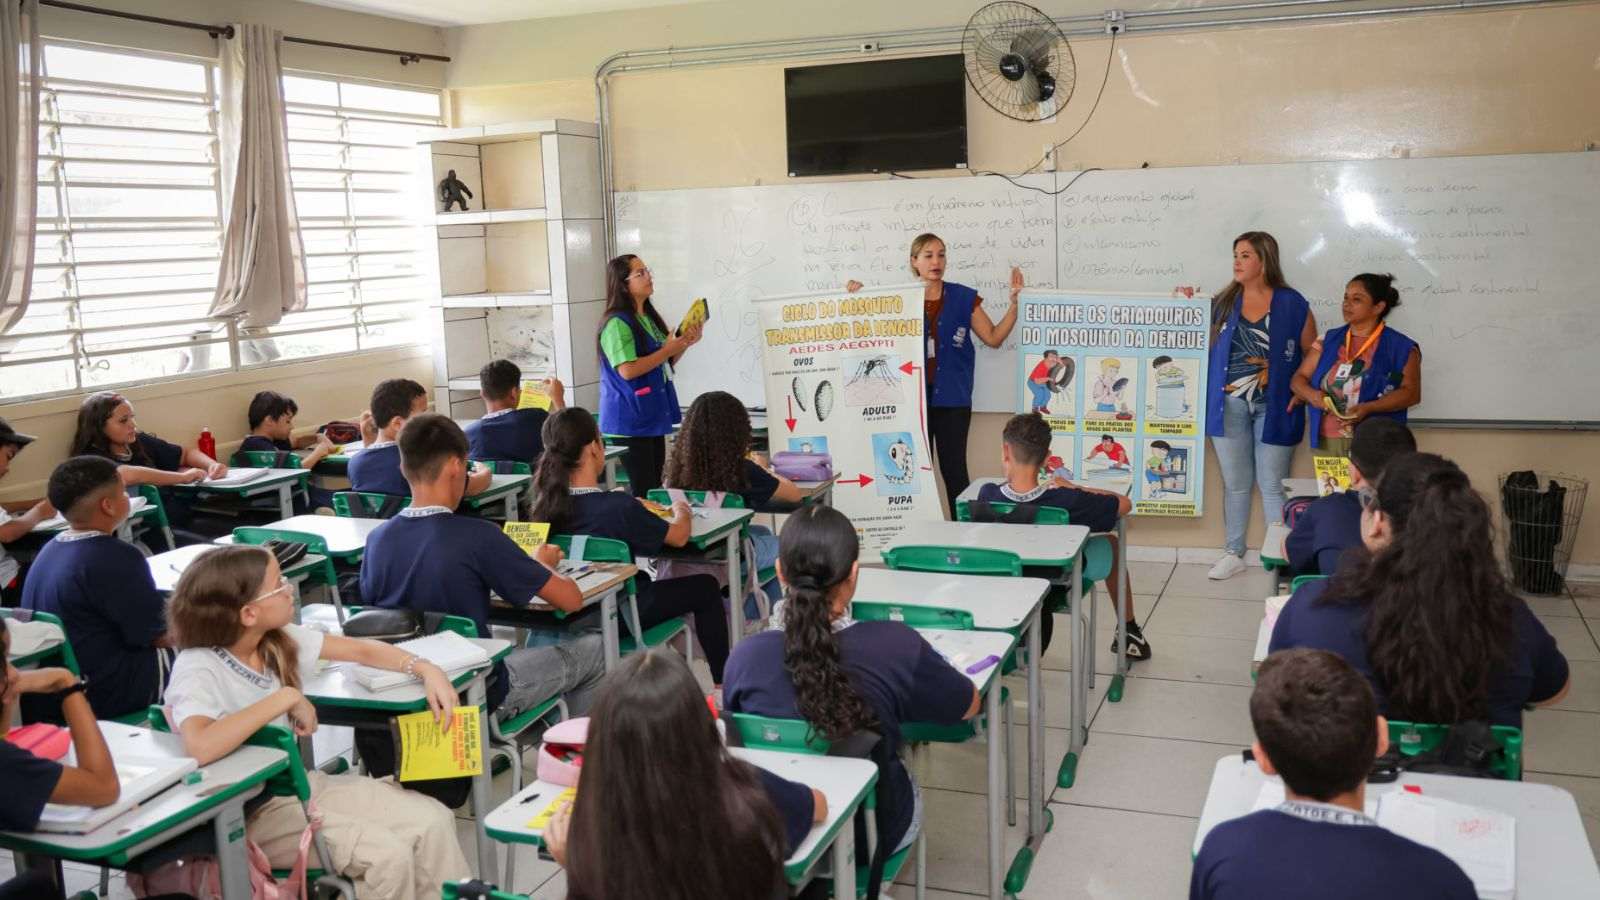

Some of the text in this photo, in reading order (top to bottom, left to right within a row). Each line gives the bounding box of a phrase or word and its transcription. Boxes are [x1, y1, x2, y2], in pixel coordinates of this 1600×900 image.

[782, 295, 903, 322] CICLO DO MOSQUITO
[1025, 303, 1084, 323] ELIMINE
[1087, 304, 1106, 325] OS
[1110, 305, 1203, 326] CRIADOUROS
[765, 324, 850, 346] TRANSMISSOR
[853, 322, 872, 338] DA
[1022, 327, 1205, 350] DO MOSQUITO DA DENGUE
[788, 338, 895, 355] AEDES AEGYPTI
[793, 356, 814, 367] OVOS
[862, 405, 896, 417] ADULTO
[888, 495, 913, 506] PUPA
